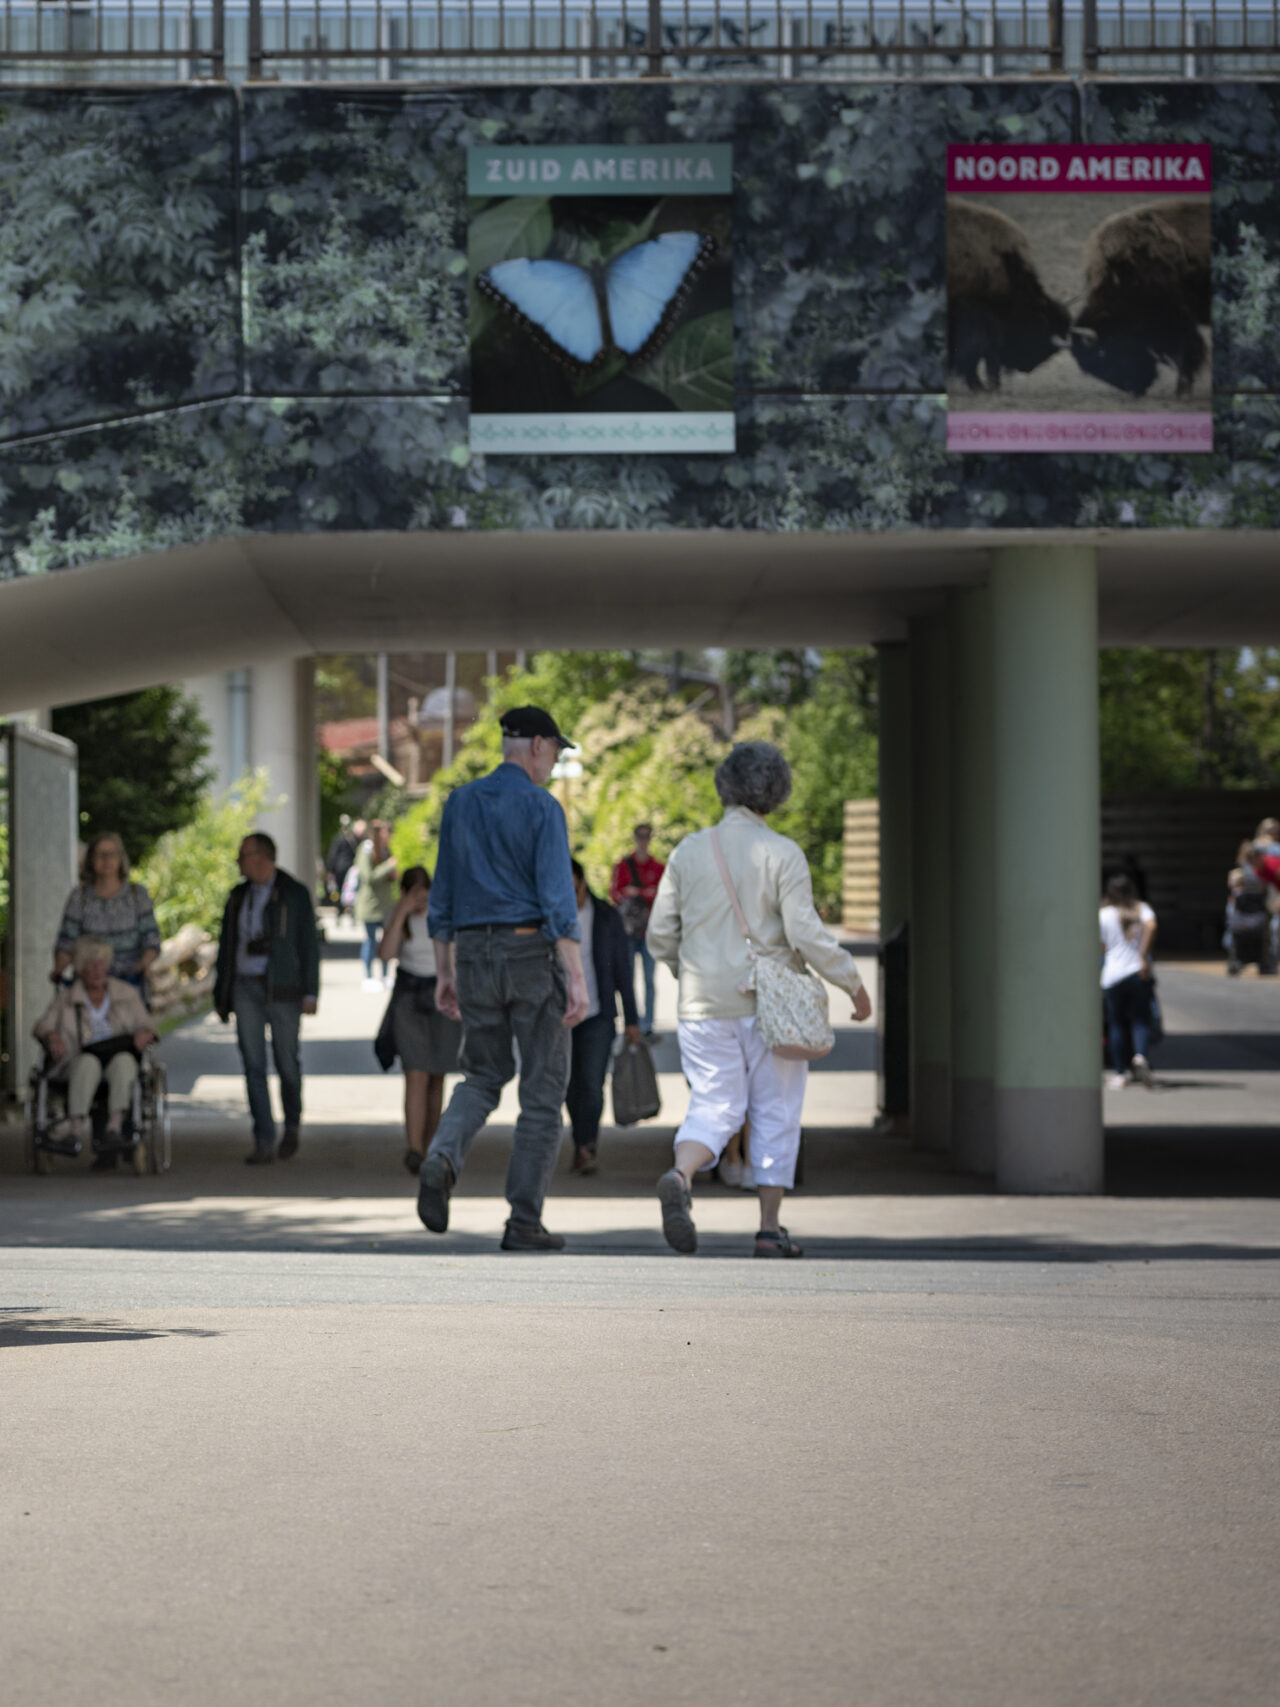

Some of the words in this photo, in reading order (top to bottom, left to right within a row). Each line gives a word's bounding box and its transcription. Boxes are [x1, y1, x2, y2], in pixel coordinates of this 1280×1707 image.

[486, 158, 561, 182] ZUID
[571, 157, 716, 182] AMERIKA
[954, 156, 1060, 181] NOORD
[1066, 156, 1205, 181] AMERIKA
